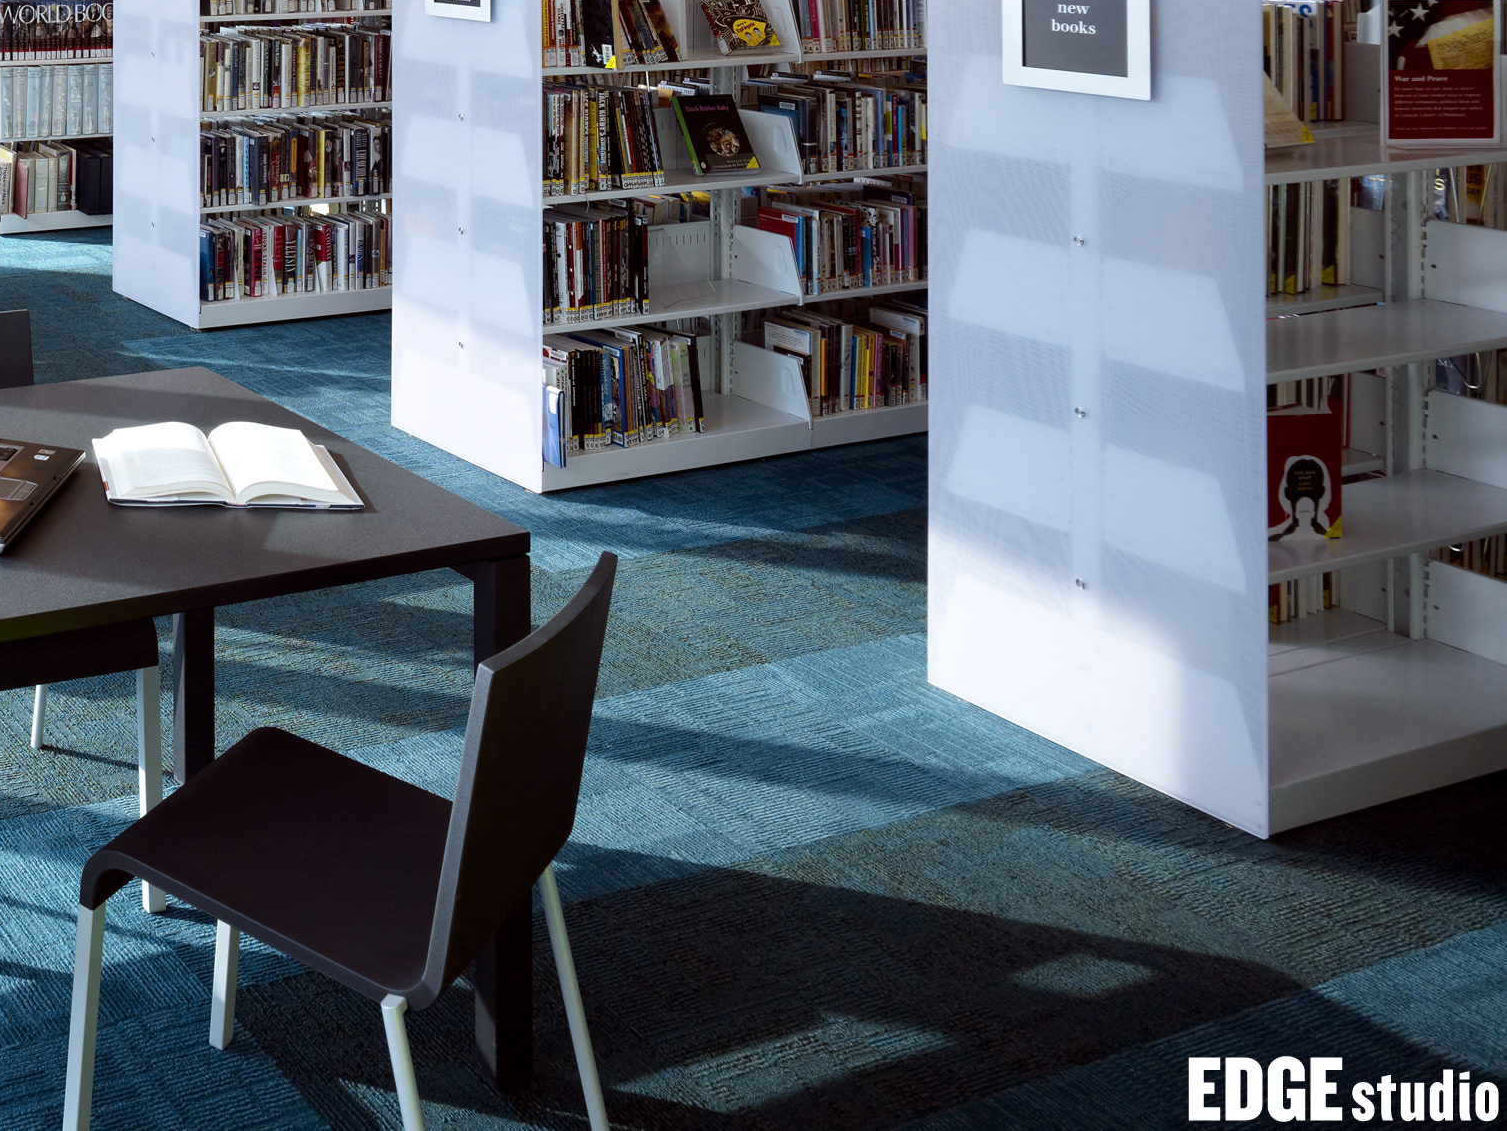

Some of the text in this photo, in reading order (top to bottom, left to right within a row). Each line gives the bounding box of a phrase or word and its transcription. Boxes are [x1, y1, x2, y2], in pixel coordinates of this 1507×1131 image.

[1057, 3, 1090, 15] new
[1051, 18, 1097, 35] books
[254, 250, 262, 280] LENI
[285, 240, 297, 272] YELTSIN
